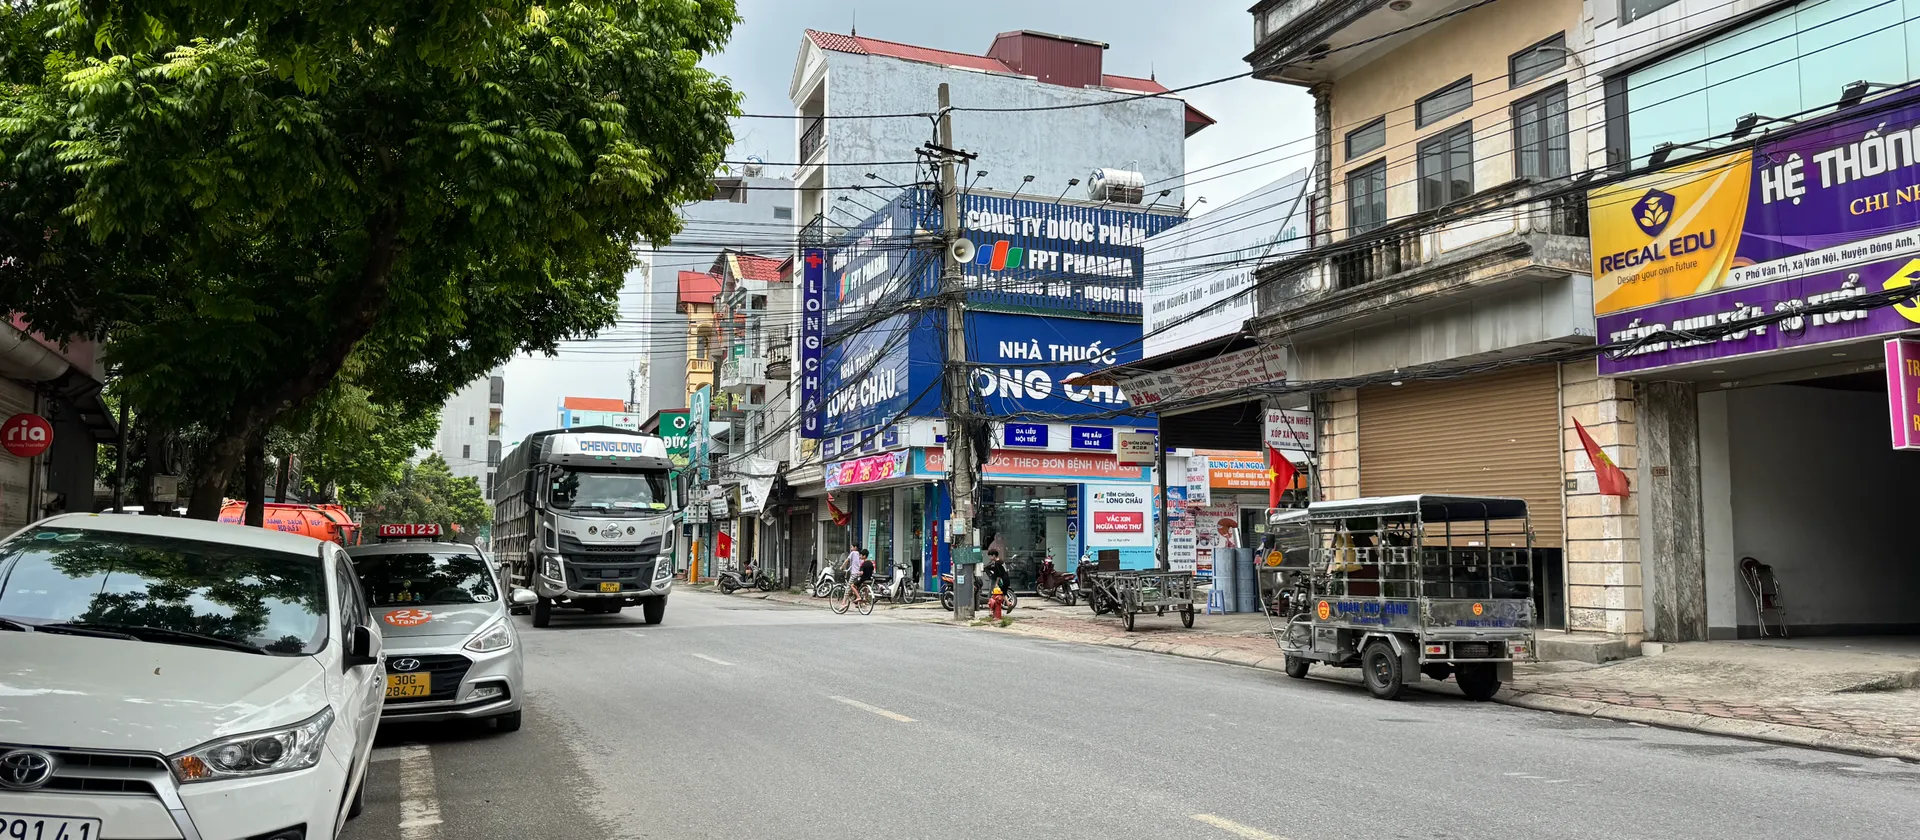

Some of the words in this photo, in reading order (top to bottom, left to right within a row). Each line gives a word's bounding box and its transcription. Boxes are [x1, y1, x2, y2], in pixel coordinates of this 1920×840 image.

[1761, 153, 1806, 206] HỆ
[1813, 122, 1920, 189] THỐN
[1850, 191, 1889, 215] CHI
[967, 208, 1015, 236] CÔNG
[1020, 217, 1042, 238] TY
[1047, 216, 1095, 245] DƯỢC
[1099, 220, 1146, 247] PHẨM
[1600, 243, 1666, 274] REGAL
[1669, 228, 1716, 257] EDU
[1745, 265, 1761, 280] Phố
[1822, 252, 1839, 265] Nội,
[1841, 247, 1868, 261] Huyện
[1870, 241, 1893, 255] Đông
[1895, 235, 1916, 249] Anh,
[1028, 249, 1059, 272] FPT
[1062, 252, 1133, 278] PHARMA
[1617, 273, 1640, 285] Design
[1641, 269, 1657, 281] your
[1658, 266, 1675, 275] own
[1675, 260, 1698, 272] future
[1153, 299, 1165, 314] KÍNH
[1209, 279, 1224, 295] KÍNH
[1226, 275, 1239, 289] DÁN
[1241, 273, 1245, 285] 2
[804, 280, 820, 350] LONG
[1000, 338, 1043, 360] NHÀ
[1049, 340, 1117, 365] THUỐC
[841, 356, 855, 380] NHÀ
[804, 357, 819, 431] CHÂU
[968, 367, 1053, 400] ONG
[1063, 372, 1128, 404] CH
[1144, 390, 1161, 403] Hoa
[827, 383, 857, 418] LONG
[8, 419, 46, 441] ria
[664, 433, 688, 449] ĐỨC
[580, 441, 642, 453] CHENGLONG
[1013, 457, 1039, 467] THEO
[1042, 457, 1065, 468] ĐƠN
[1068, 457, 1093, 472] BỆNH
[1095, 458, 1117, 473] VIỆN
[1208, 460, 1228, 469] RUNG
[1230, 458, 1244, 469] TÂM
[1245, 461, 1265, 471] NGOẠ
[381, 523, 407, 535] Taxi
[411, 523, 437, 535] 123
[1096, 522, 1114, 530] NGỪA
[1106, 514, 1119, 522] VẮC
[387, 609, 433, 623] 123
[386, 685, 425, 697] 284.77
[394, 674, 417, 686] 30G
